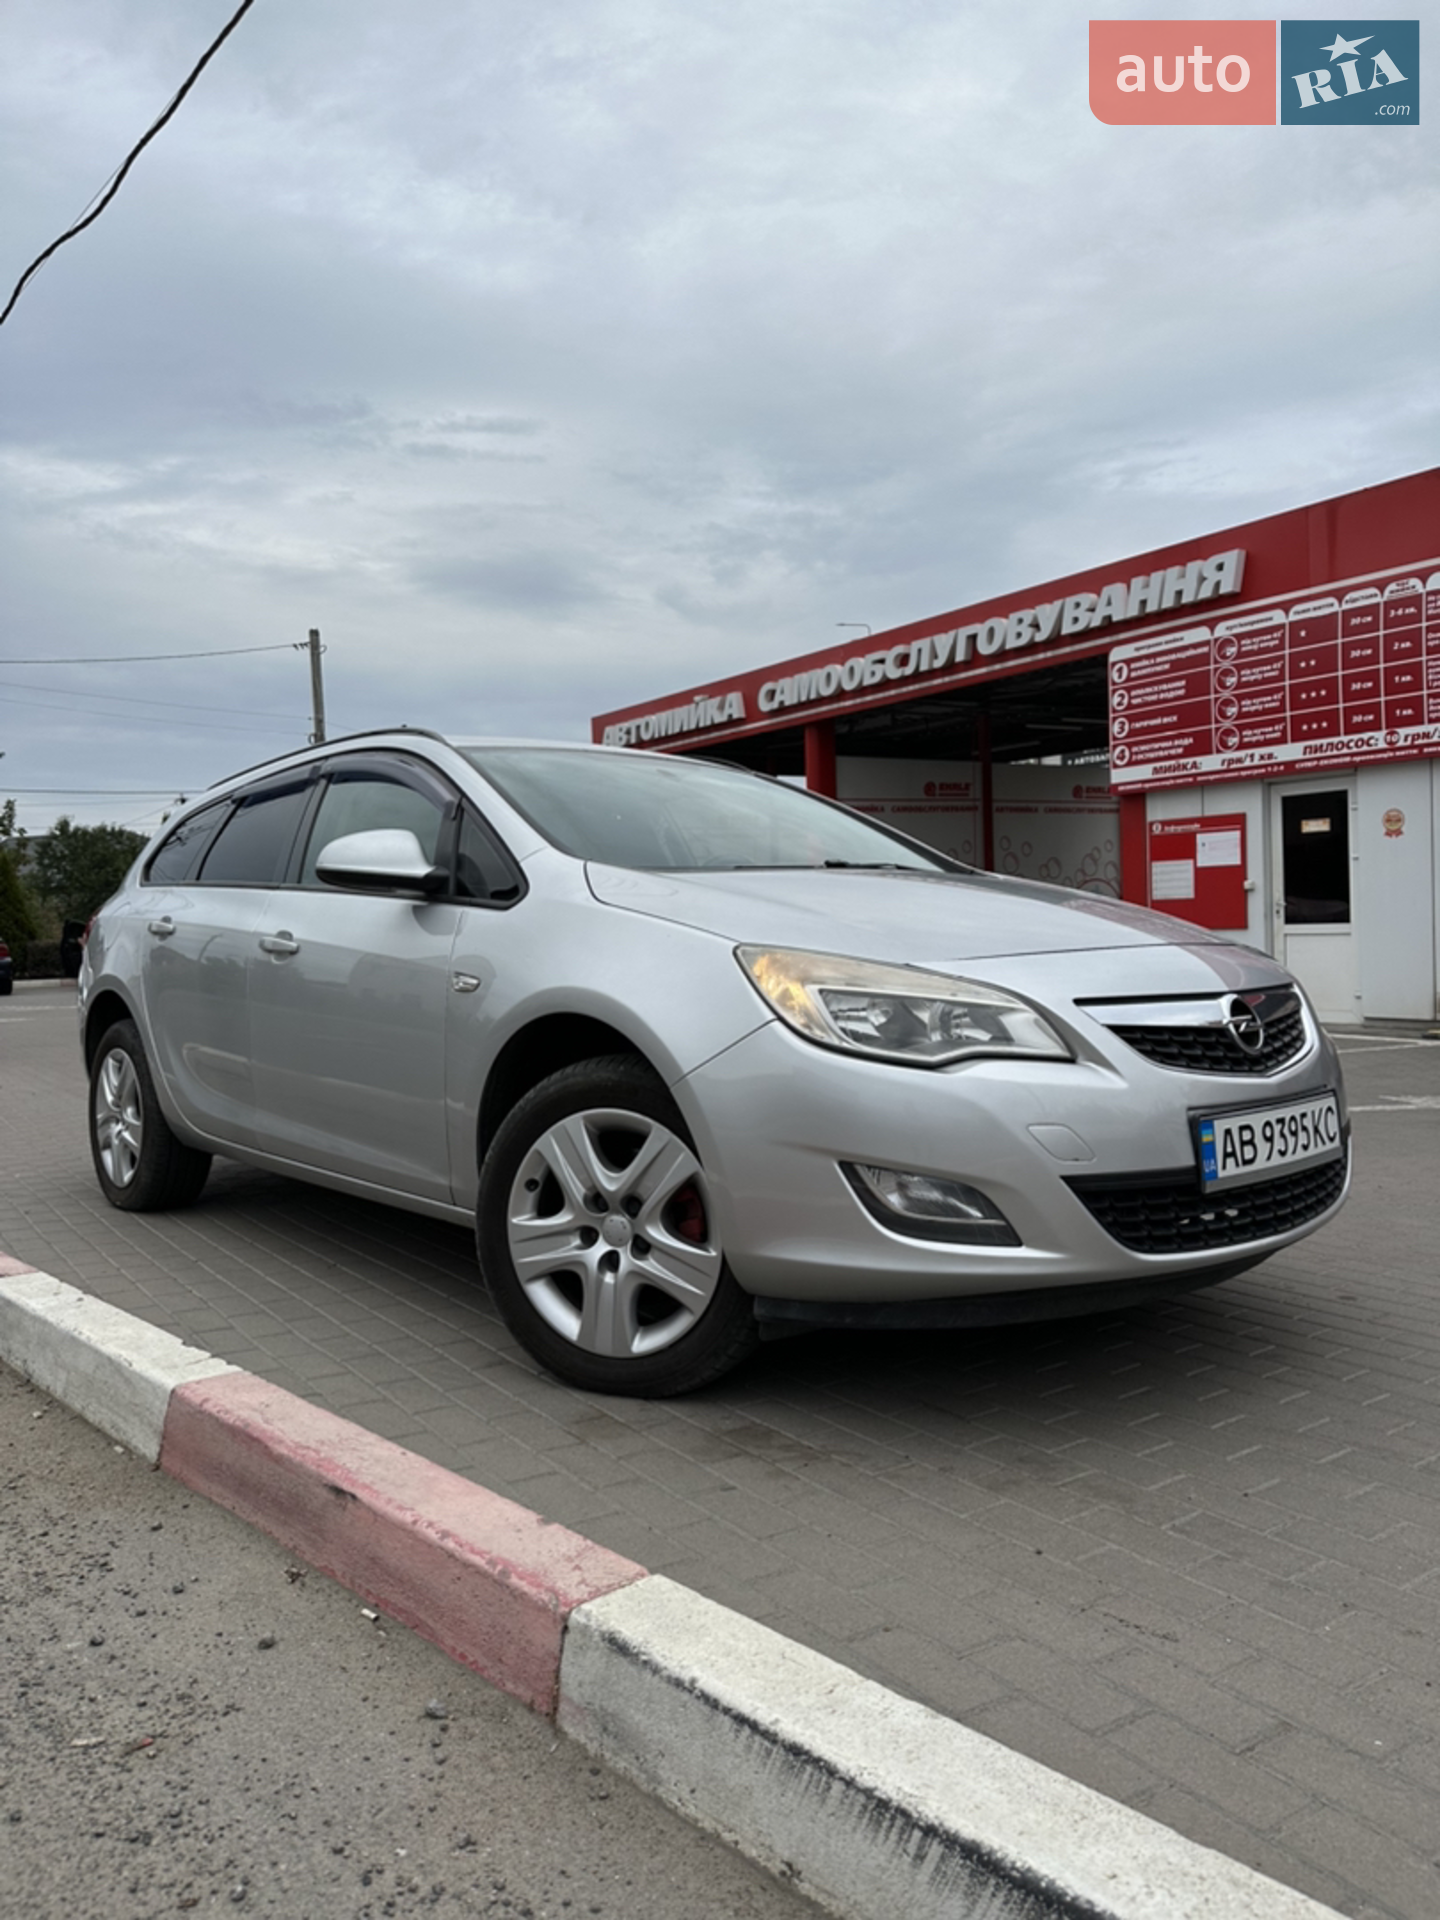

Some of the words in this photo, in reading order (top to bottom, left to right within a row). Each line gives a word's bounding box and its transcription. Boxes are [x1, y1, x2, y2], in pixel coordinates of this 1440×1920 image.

[602, 691, 746, 747] АВТОМИЙКА
[757, 549, 1247, 713] САМООБСЛУГОВУВАННЯ
[1302, 735, 1380, 756] ПИЛОСОС:
[1151, 759, 1203, 777] МИЙКА:
[1258, 752, 1279, 762] хв.
